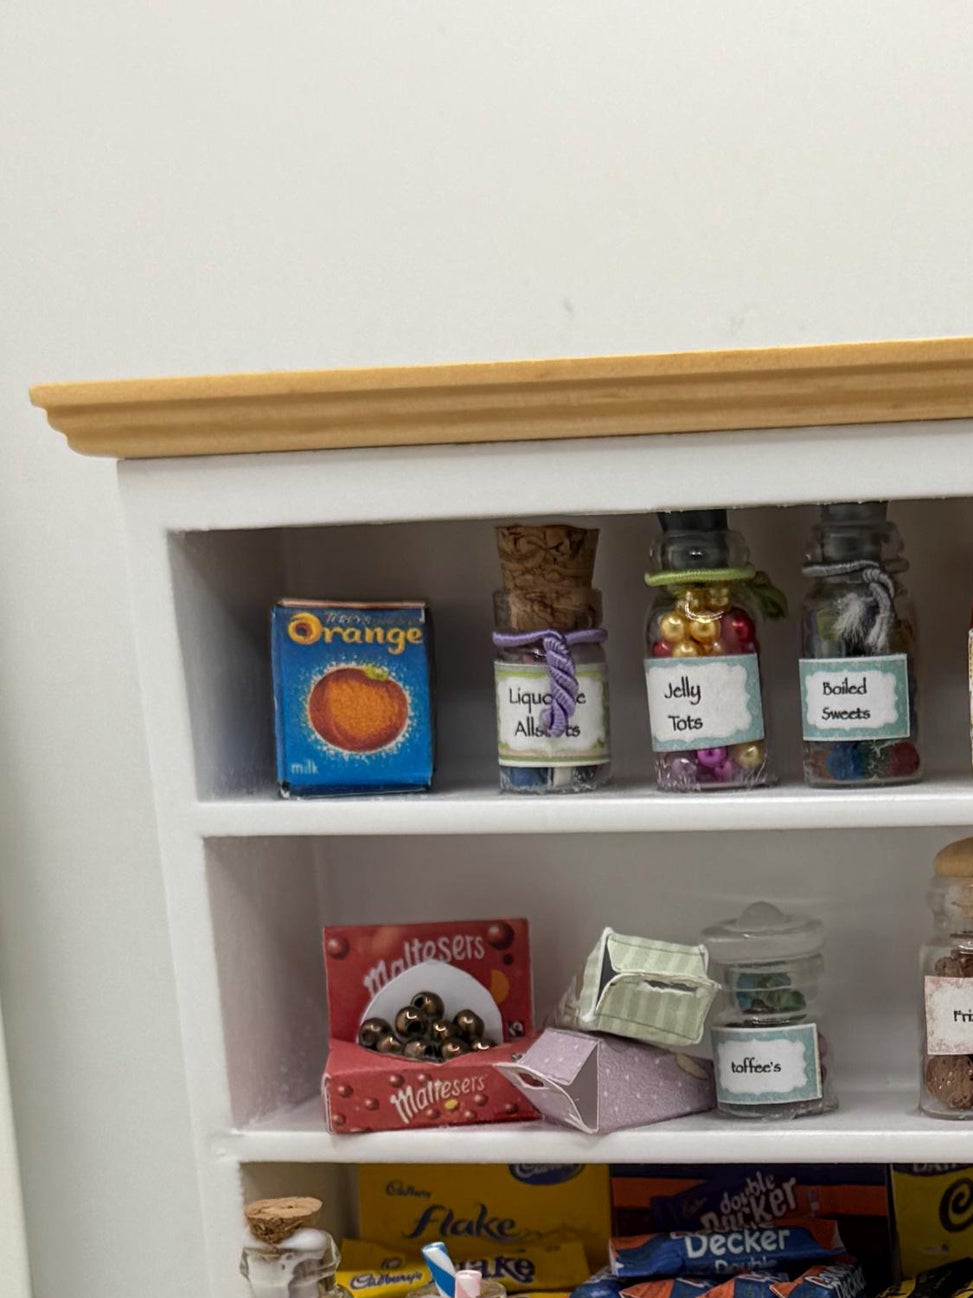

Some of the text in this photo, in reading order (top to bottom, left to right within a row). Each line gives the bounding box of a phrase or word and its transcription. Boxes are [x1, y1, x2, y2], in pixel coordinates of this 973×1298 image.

[288, 612, 423, 655] Orange
[664, 676, 702, 705] Jelly
[822, 677, 867, 696] Boiled
[668, 715, 703, 732] Tots
[821, 707, 870, 721] Sweets
[291, 761, 319, 776] milk
[731, 1057, 782, 1074] toffee's
[390, 1076, 485, 1124] Maltesers
[684, 1229, 790, 1259] Decker
